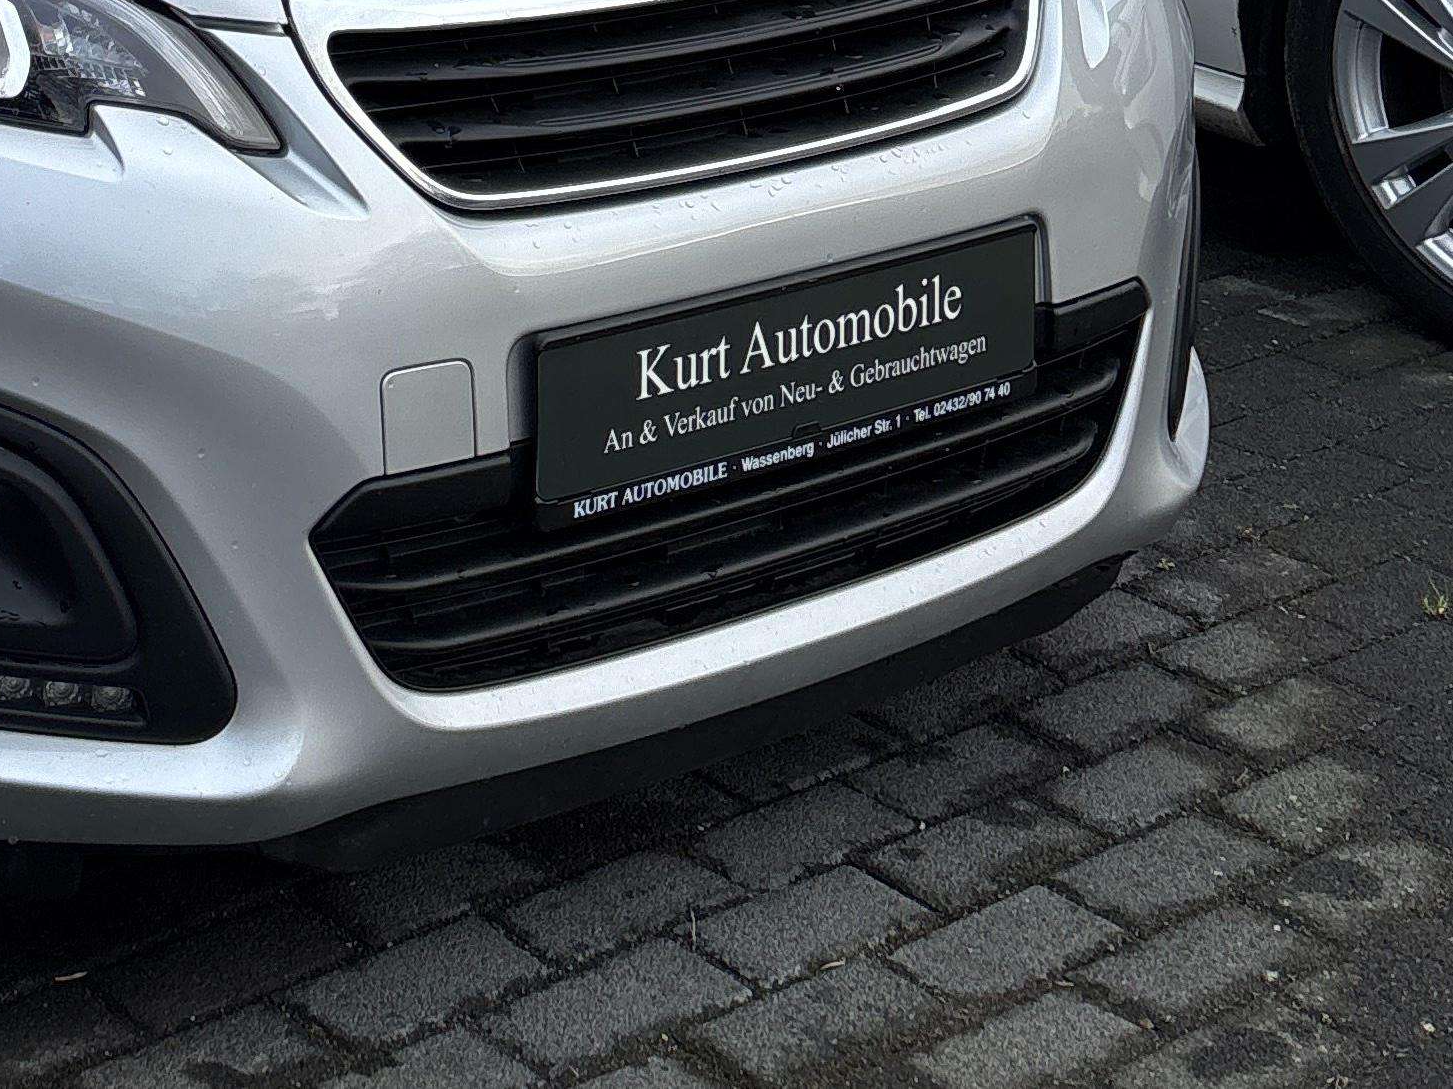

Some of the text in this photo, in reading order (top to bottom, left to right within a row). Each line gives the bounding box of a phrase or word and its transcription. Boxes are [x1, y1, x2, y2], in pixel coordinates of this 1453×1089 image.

[603, 334, 987, 454] An & Verkauf von Neu- & Gebrauchtwagen
[635, 274, 963, 401] Kurt Automobile
[573, 381, 1011, 519] KURT AUTOMOBILE Wassenberg Jülicher Str. 1 Tel. 02432/90 74 40
